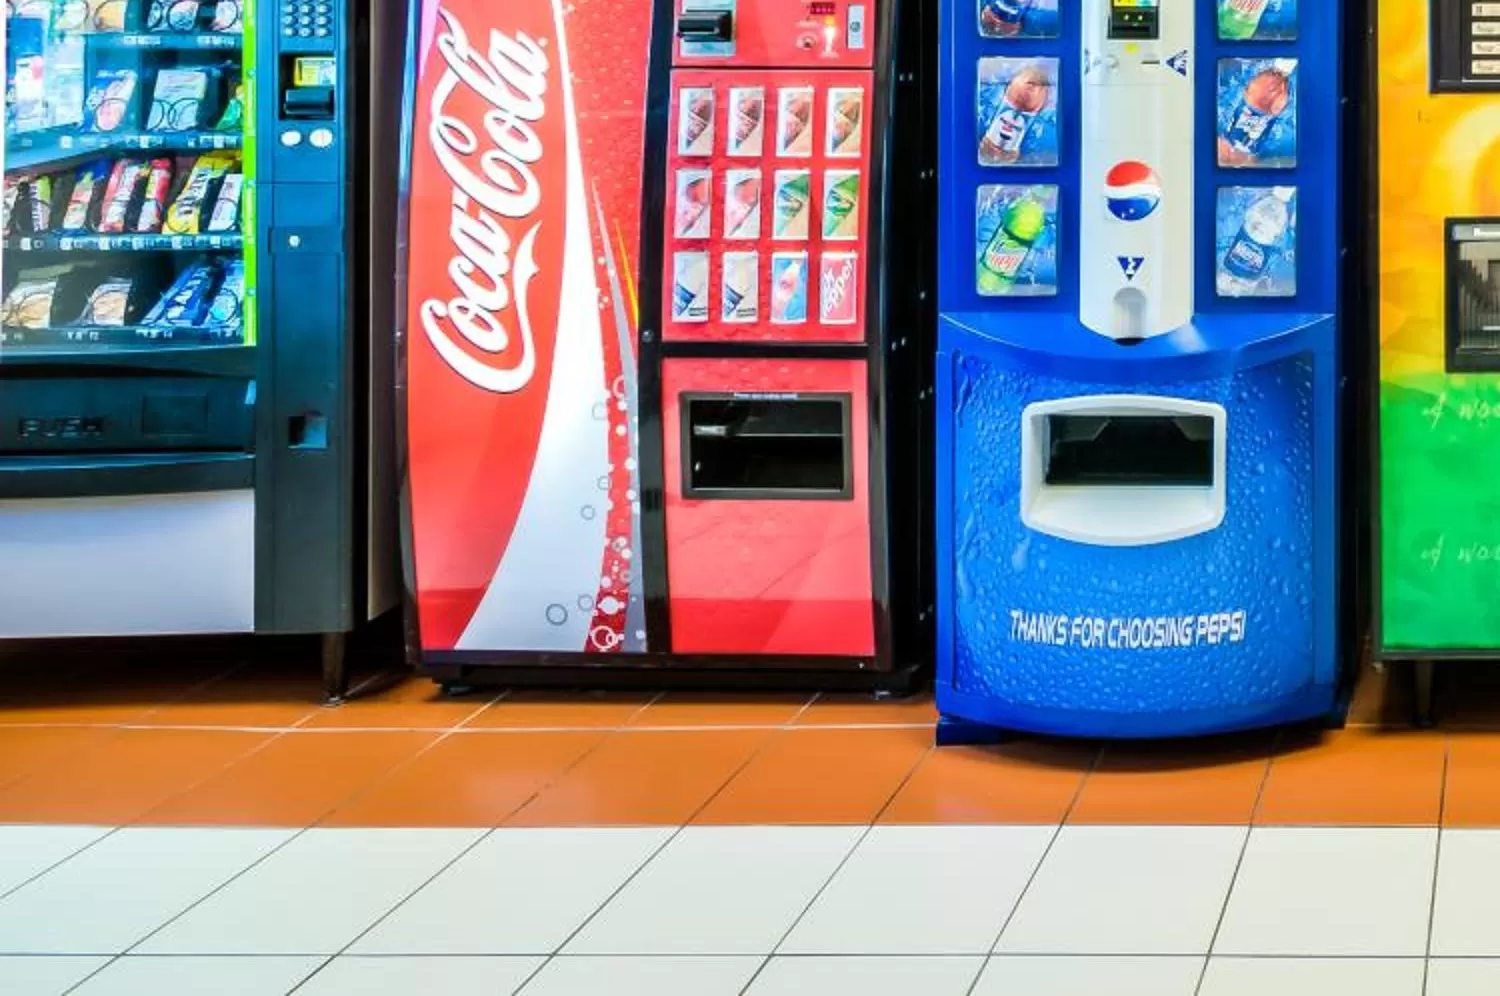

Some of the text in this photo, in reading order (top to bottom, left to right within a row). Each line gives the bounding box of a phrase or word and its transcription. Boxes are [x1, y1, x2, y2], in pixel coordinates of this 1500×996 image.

[420, 6, 549, 395] Coca-Cola
[1010, 609, 1246, 648] THANKS FOR CHOOSING PEPSI
